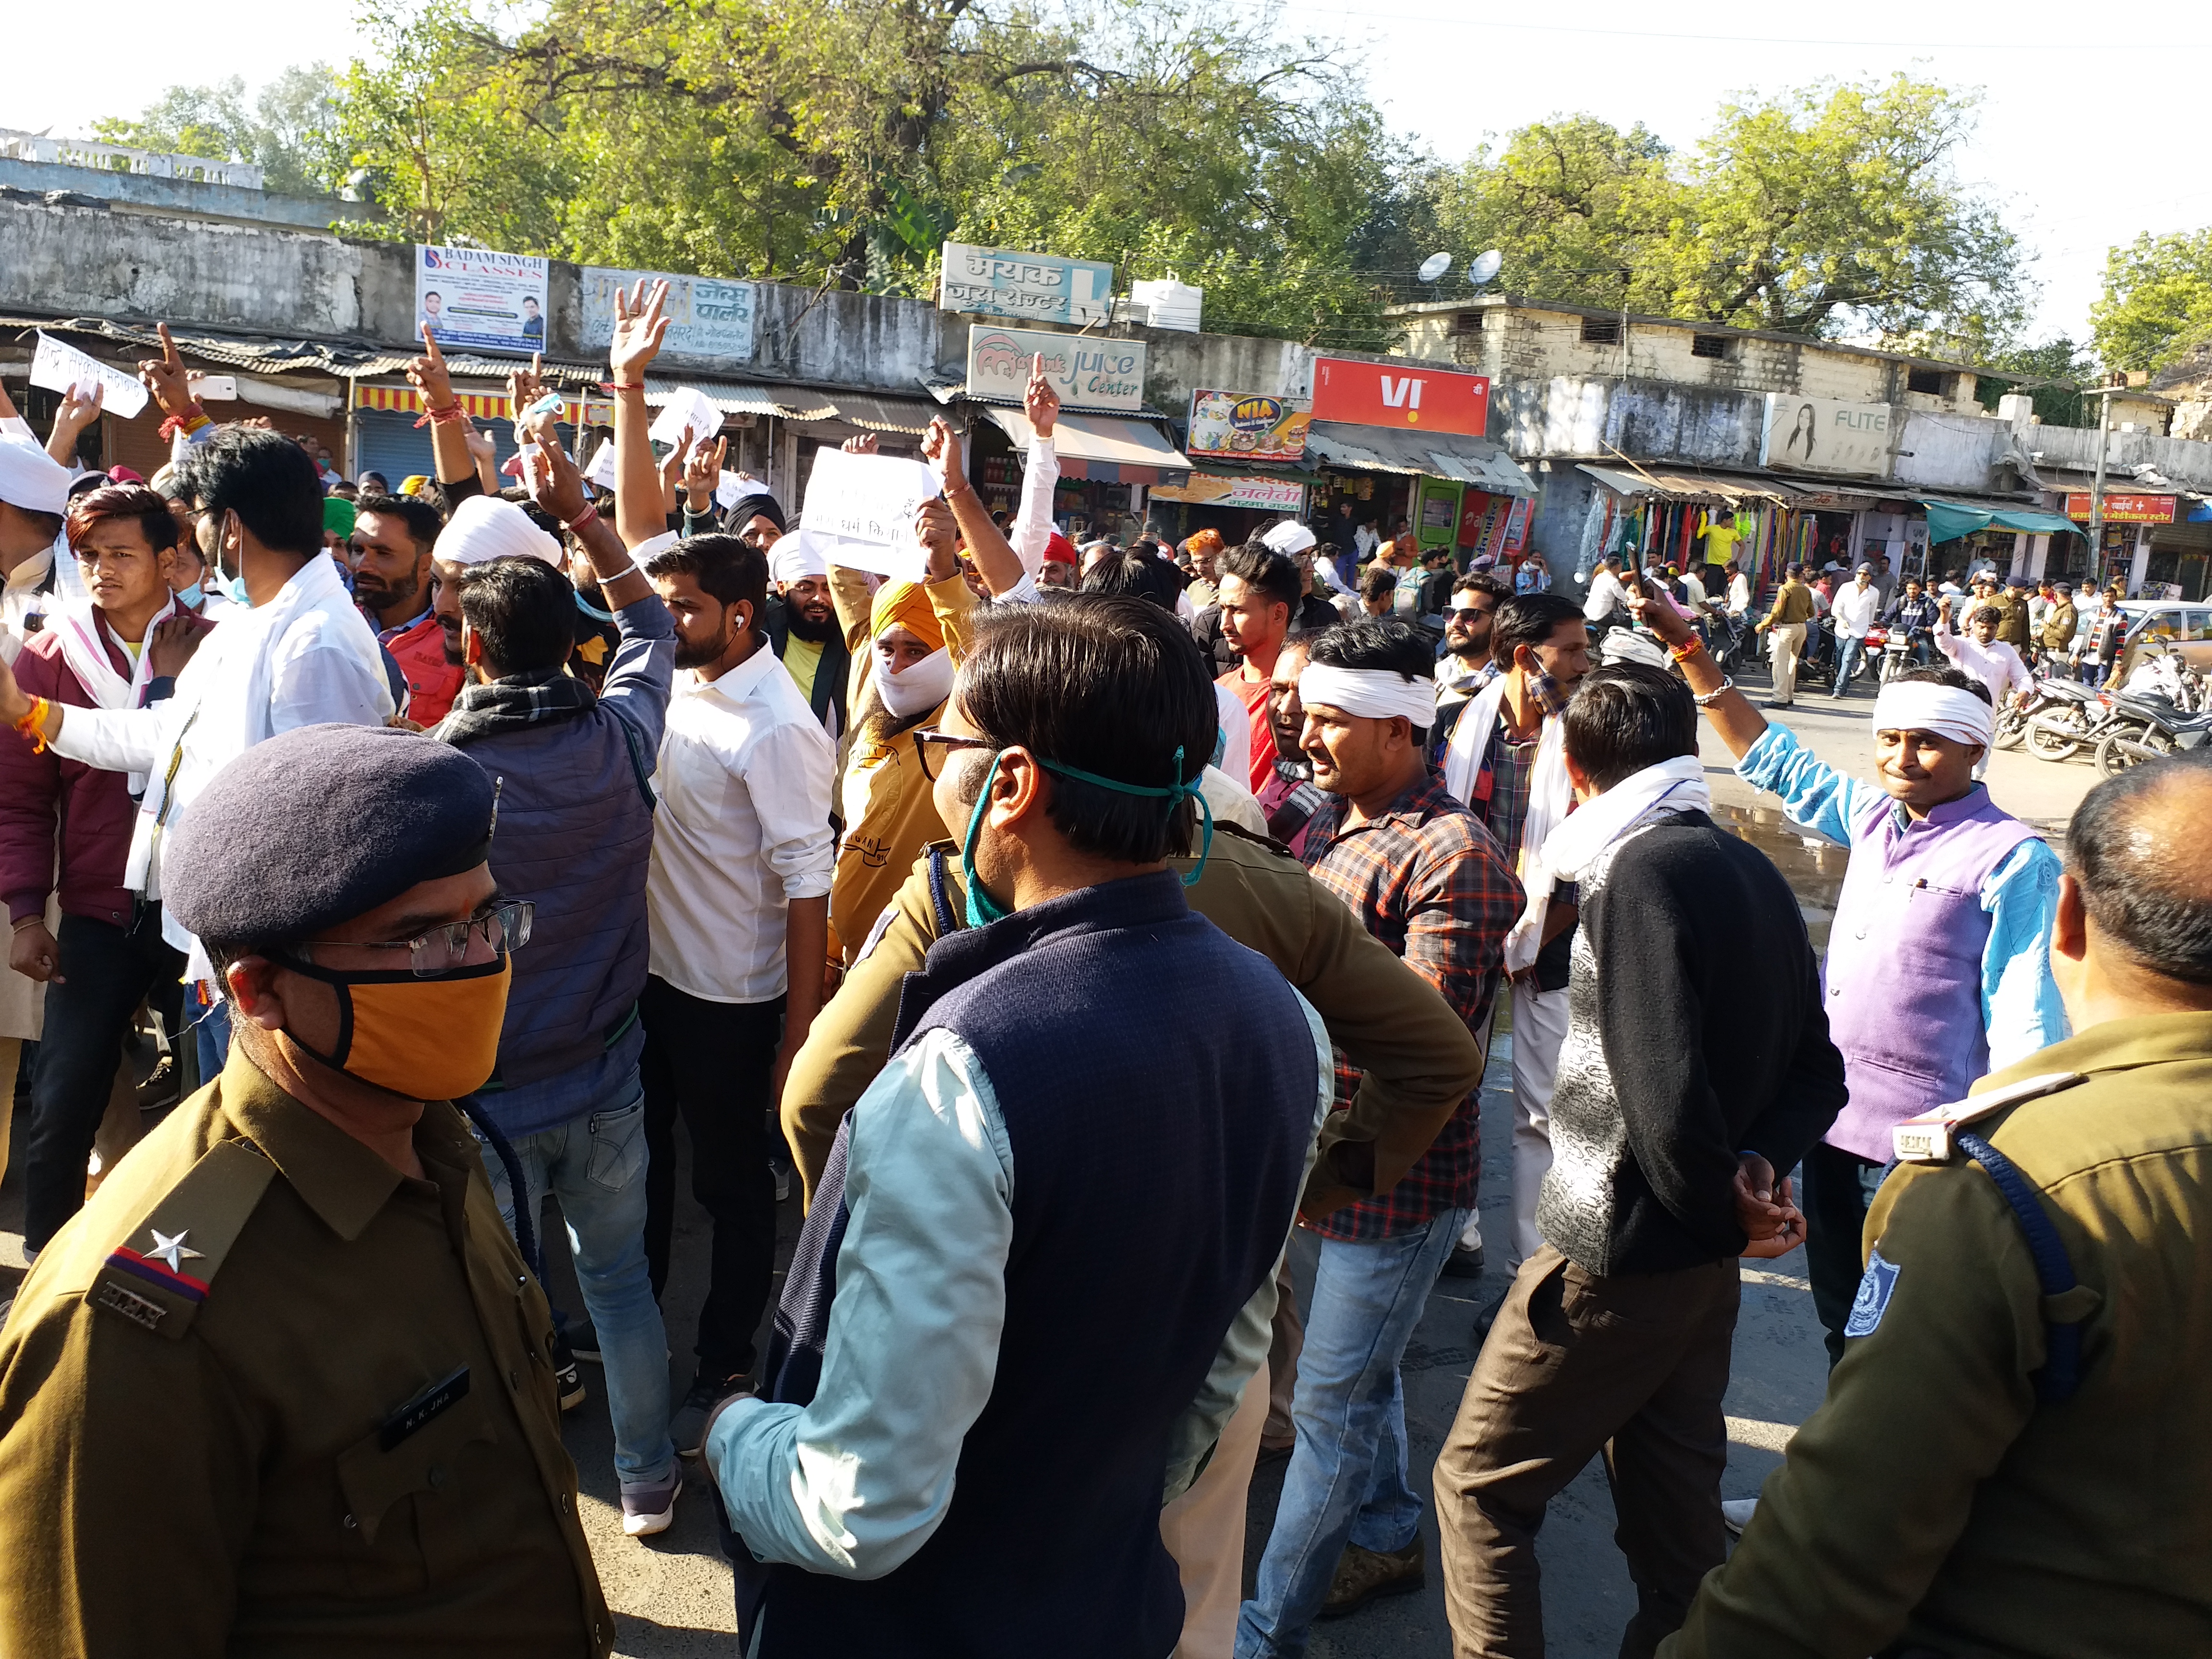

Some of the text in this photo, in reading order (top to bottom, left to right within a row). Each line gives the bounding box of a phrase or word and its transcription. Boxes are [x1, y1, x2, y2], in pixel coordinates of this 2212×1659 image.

[445, 249, 495, 264] BADAM
[499, 256, 541, 269] SINGH
[445, 262, 542, 278] CLASSES
[696, 303, 749, 324] पार्लर
[1059, 340, 1134, 385] juice
[1087, 375, 1138, 396] Center
[1472, 383, 1484, 395] वी
[1835, 410, 1886, 432] FLITE
[1232, 486, 1303, 502] जलेबी
[1228, 498, 1299, 511] गरमा गरम
[431, 1393, 450, 1411] JHA
